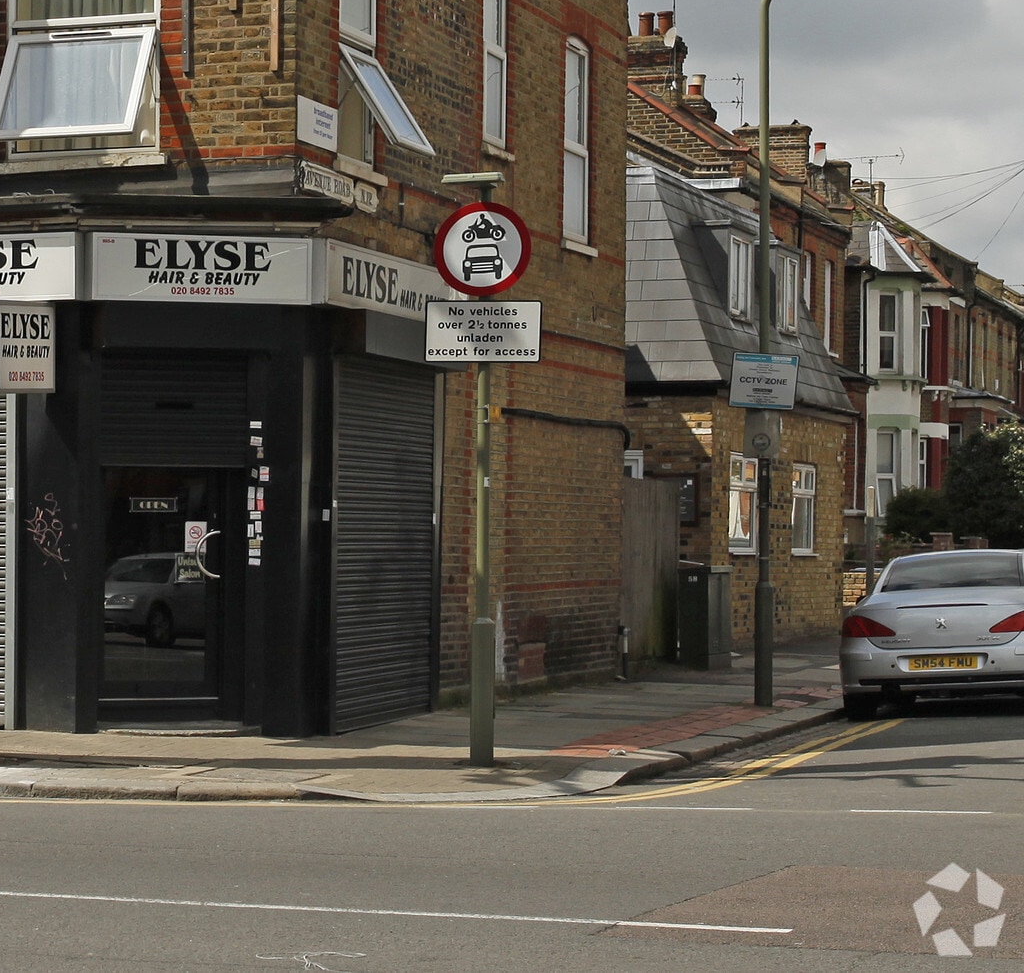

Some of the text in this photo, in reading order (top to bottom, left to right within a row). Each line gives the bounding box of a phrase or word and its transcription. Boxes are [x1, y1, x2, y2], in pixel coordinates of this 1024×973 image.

[304, 171, 331, 192] AVENUE
[334, 179, 350, 197] ROAD
[134, 239, 272, 272] ELYSE
[148, 271, 260, 286] HAIR & BEAUTY
[342, 255, 398, 305] ELYSE
[400, 289, 416, 311] HAIR
[171, 287, 235, 295] 020 8492 7835
[448, 307, 518, 316] No vehicles
[1, 313, 51, 340] ELYSE
[438, 321, 463, 329] over
[488, 320, 527, 329] tonnes
[457, 333, 503, 343] unladen
[2, 345, 50, 359] HAIR & BEAUTY
[428, 347, 536, 357] except for access
[8, 371, 45, 381] 020 8492 7835
[740, 376, 762, 384] CCTV
[139, 501, 168, 509] OPEN
[914, 657, 972, 668] SM54 FMU
